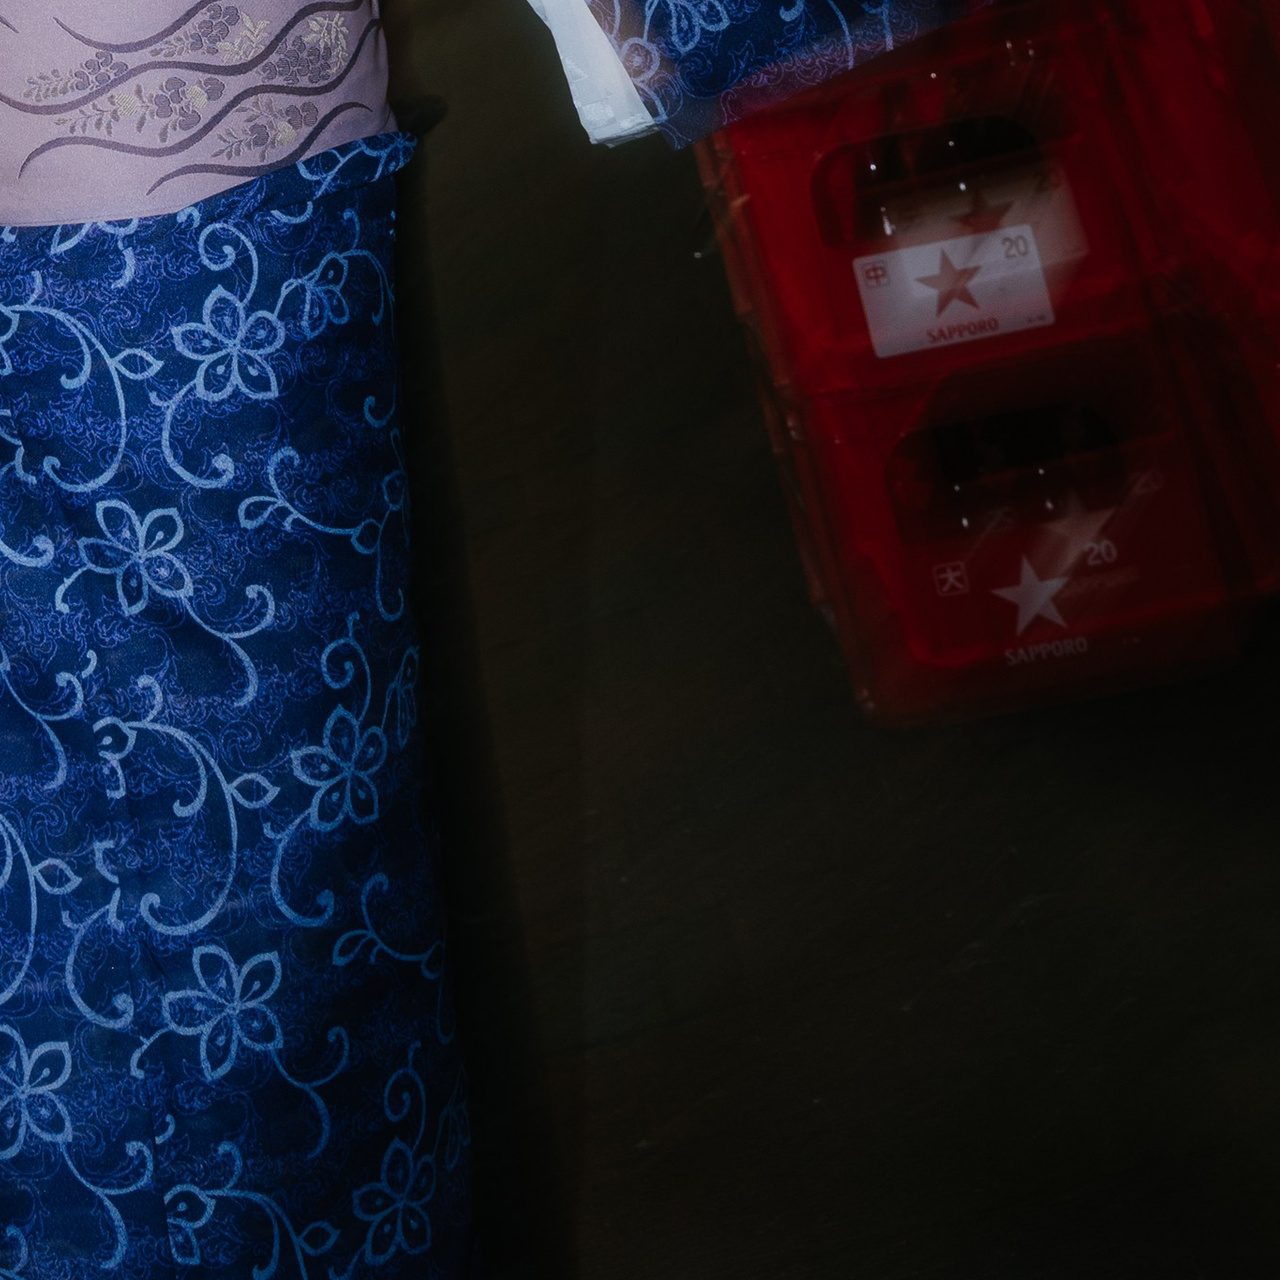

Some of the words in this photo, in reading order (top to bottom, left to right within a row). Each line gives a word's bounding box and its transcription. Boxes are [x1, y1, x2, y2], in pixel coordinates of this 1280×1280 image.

[1002, 234, 1030, 259] 20
[865, 264, 887, 286] 中
[926, 317, 1000, 344] SAPPORO
[1085, 539, 1119, 566] 20
[937, 567, 964, 593] 大
[1003, 636, 1089, 667] SAPPORO
